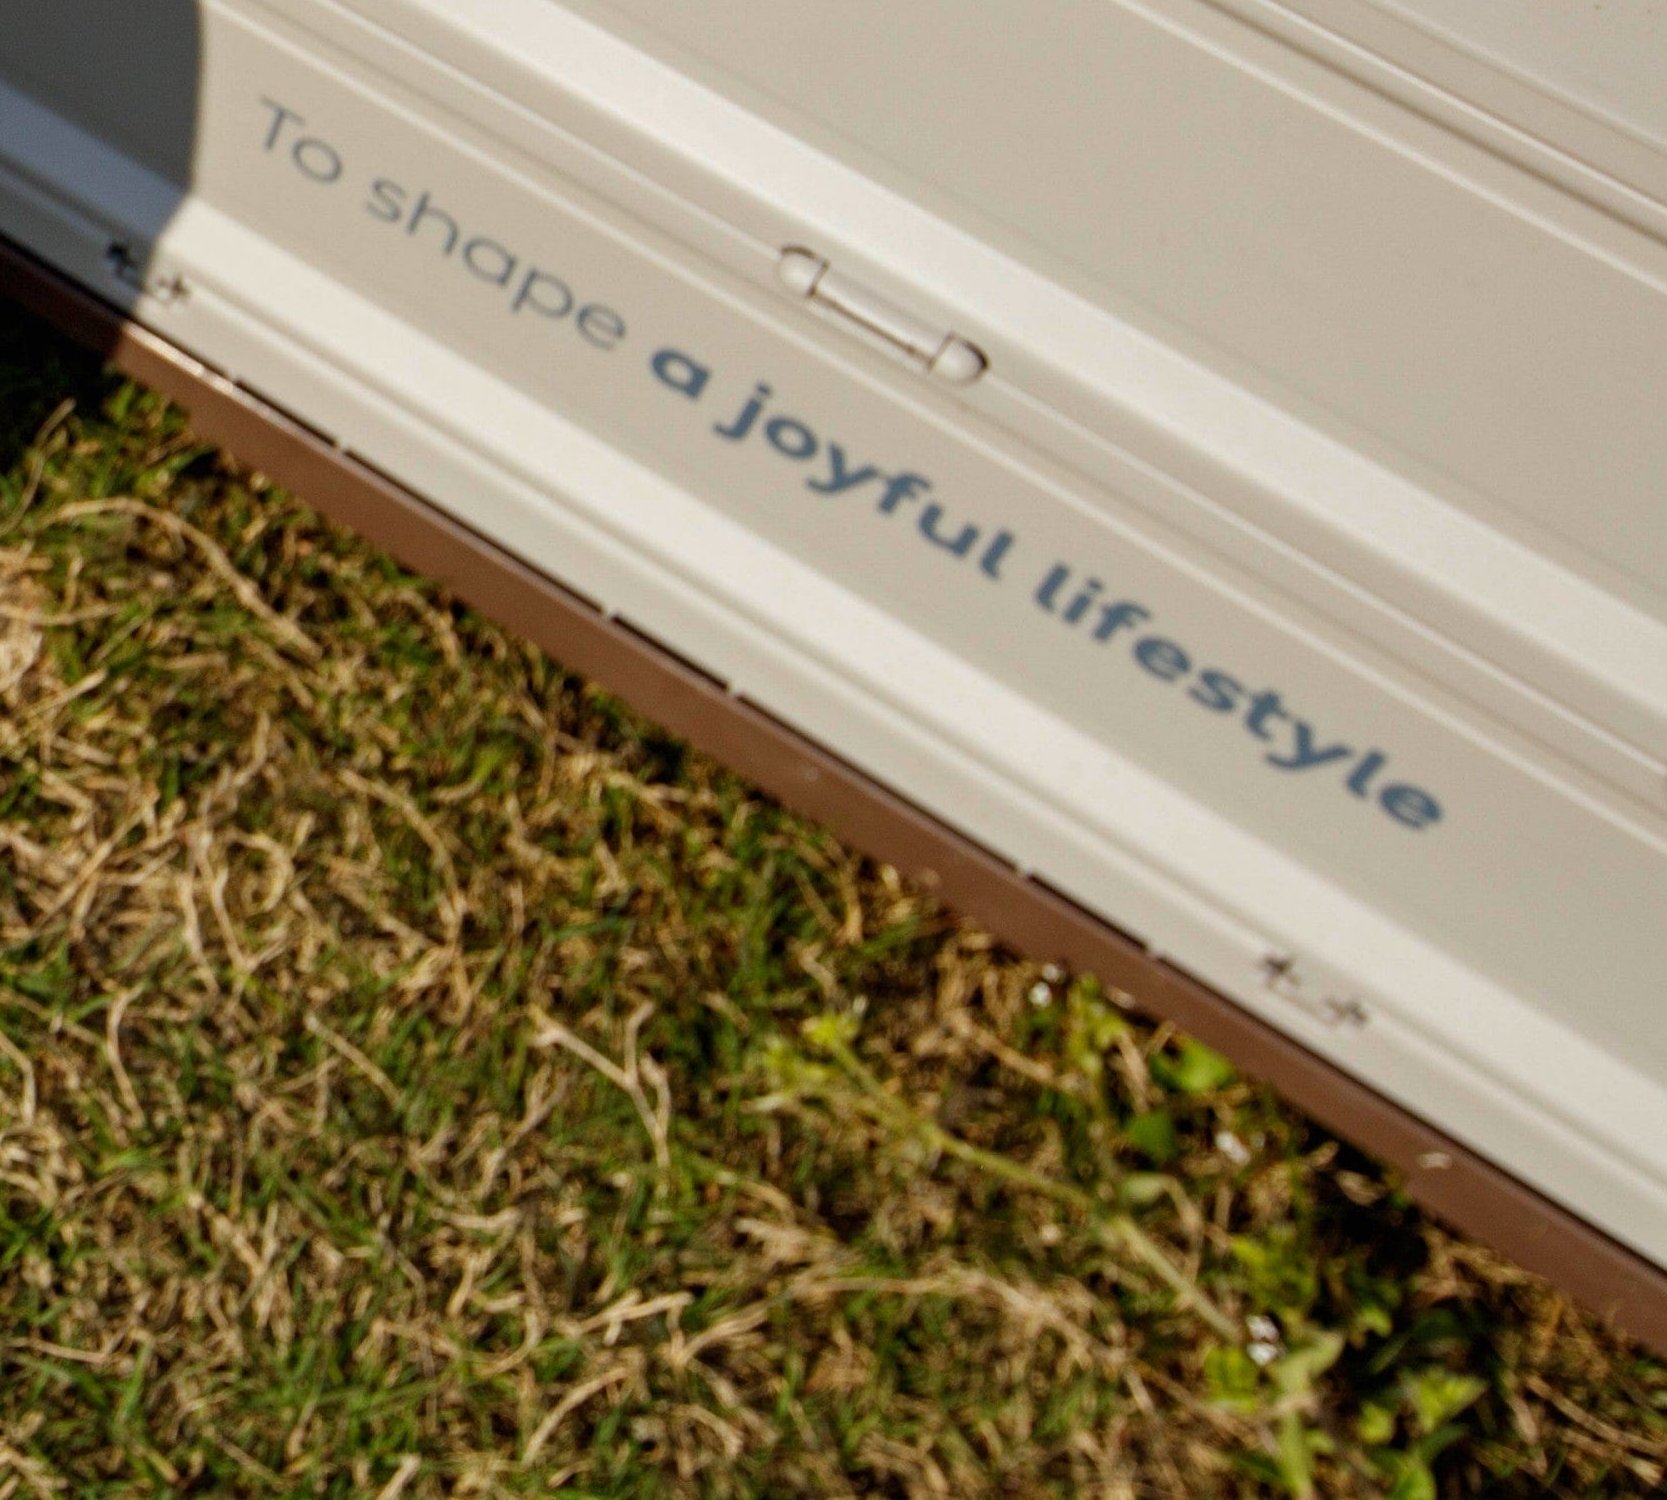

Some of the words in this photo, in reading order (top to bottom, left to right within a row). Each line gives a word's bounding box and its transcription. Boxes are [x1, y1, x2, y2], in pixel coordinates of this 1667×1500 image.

[255, 95, 344, 185] To
[365, 176, 629, 350] shape
[647, 346, 713, 400] a
[713, 382, 1019, 580] joyful
[1032, 561, 1446, 835] lifestyle
